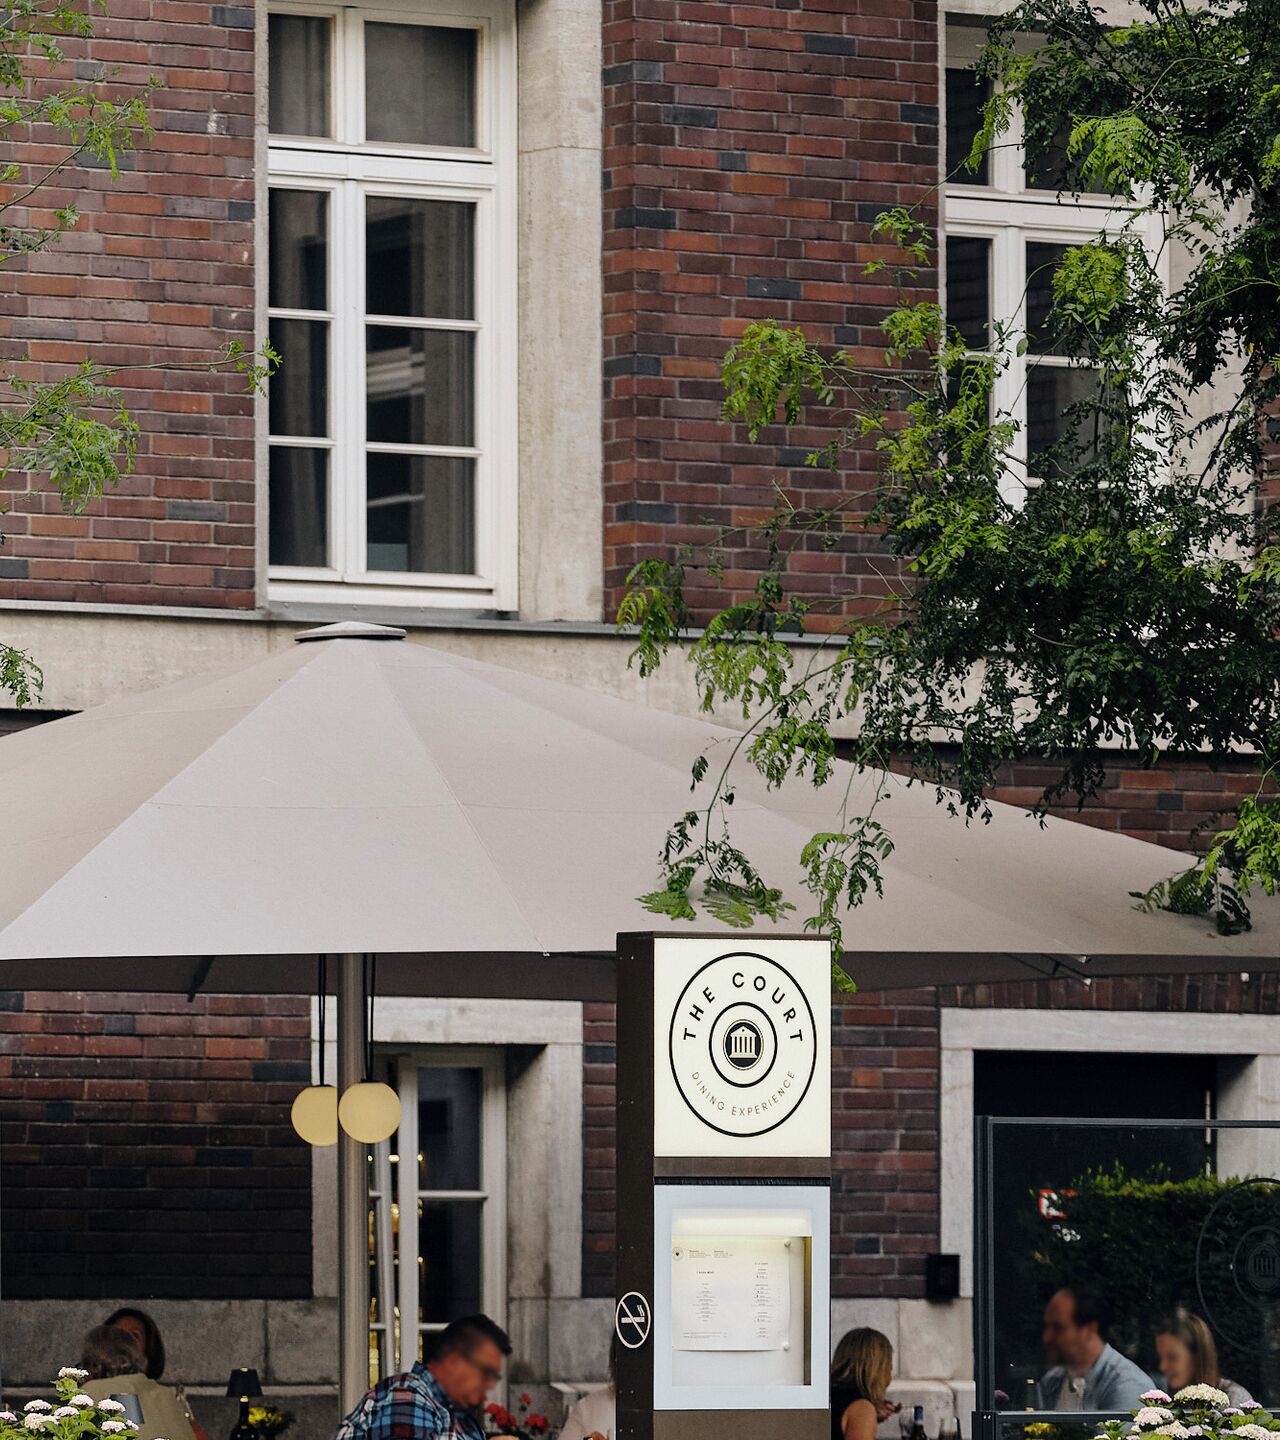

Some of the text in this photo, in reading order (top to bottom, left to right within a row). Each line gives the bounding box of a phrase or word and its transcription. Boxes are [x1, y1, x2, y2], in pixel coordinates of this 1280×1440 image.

[683, 972, 803, 1042] THE COURT
[691, 1070, 796, 1117] DINING EXPERIENCE
